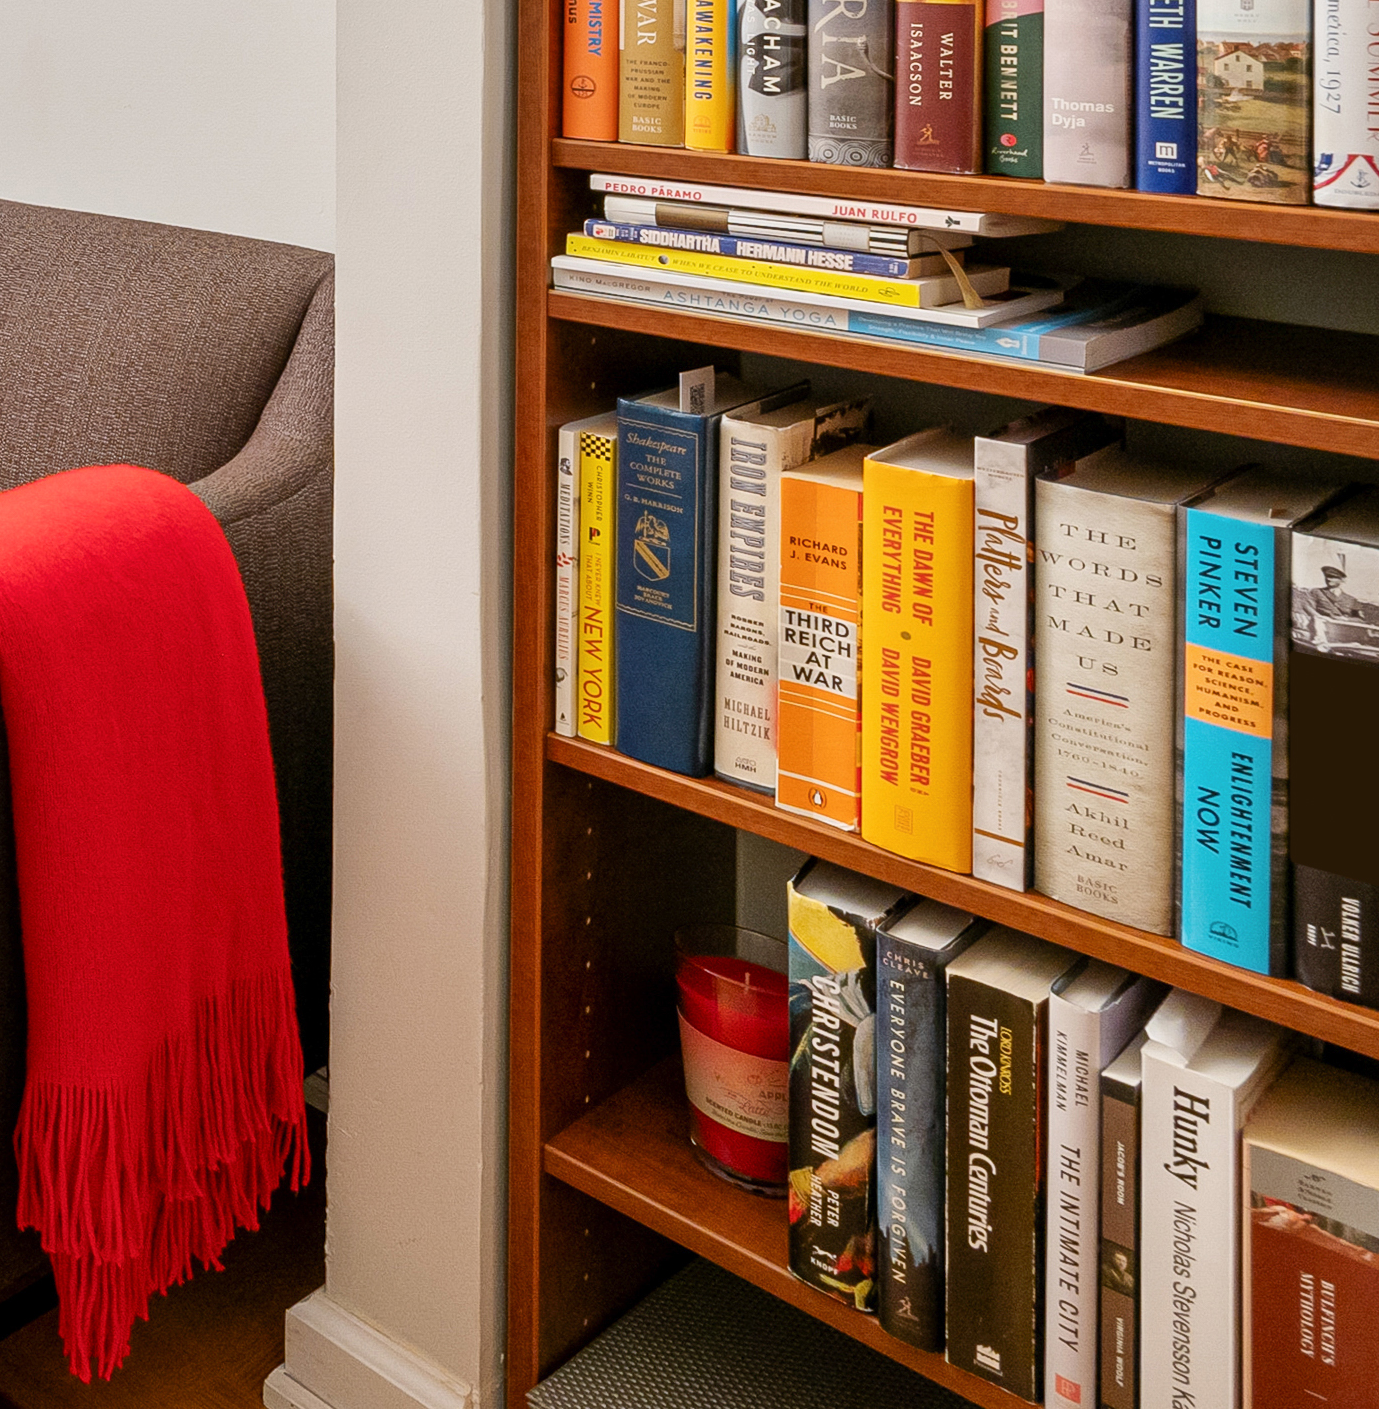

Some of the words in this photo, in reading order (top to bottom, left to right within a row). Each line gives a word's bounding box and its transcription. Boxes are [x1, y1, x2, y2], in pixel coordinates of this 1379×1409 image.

[694, 0, 714, 100] AWAKENING
[909, 23, 923, 107] ISAACSON
[939, 33, 954, 100] WALTER
[1150, 43, 1184, 120] WARREN
[1319, 70, 1341, 114] 1927
[1052, 97, 1114, 113] Thomas
[1052, 113, 1085, 128] Dyja
[605, 182, 646, 195] PEDRO
[651, 185, 702, 201] PÁRAMO
[832, 205, 866, 219] JUAN
[872, 207, 917, 224] RULFO
[640, 229, 720, 253] SIDDHARTHA
[736, 241, 805, 266] HERMANN
[807, 251, 853, 271] HESSE
[664, 291, 770, 316] ASHTANGA
[780, 306, 837, 327] YOGA
[626, 432, 687, 456] Shakespeare
[645, 454, 667, 466] THE
[630, 462, 682, 481] COMPLETE
[637, 474, 675, 489] WORKS
[730, 437, 767, 497] IRON
[913, 511, 934, 545] THE
[1060, 523, 1136, 550] THE
[729, 499, 765, 602] EMPIRES
[882, 505, 902, 613] EVERYTHING
[1038, 549, 1163, 588] WORDS
[913, 552, 934, 599] DAWN
[1198, 536, 1222, 629] PINKER
[1234, 542, 1258, 638] STEVEN
[913, 603, 934, 626] OF
[1049, 585, 1149, 618] THAT
[584, 605, 603, 662] NEW
[785, 610, 850, 638] THIRD
[785, 627, 851, 658] REICH
[1047, 615, 1151, 652] MADE
[792, 665, 843, 692] WAR
[805, 652, 832, 670] AT
[1077, 655, 1118, 677] US
[583, 669, 603, 729] YORK
[724, 697, 770, 721] MICHAEL
[724, 716, 770, 740] HILTZIK
[1196, 786, 1220, 854] NOW
[1230, 751, 1253, 909] ENLIGHTENMENT
[970, 1014, 998, 1055] The
[811, 975, 840, 1161] CHRISTENDOM
[1056, 1030, 1068, 1112] KIMMELMAN
[1075, 1049, 1089, 1108] MICHAEL
[969, 1056, 997, 1150] Ottoman
[1163, 1085, 1210, 1191] Hunky
[1060, 1143, 1081, 1187] THE
[810, 1174, 822, 1227] HEATHER
[827, 1189, 839, 1227] PETER
[968, 1152, 996, 1253] Centuries
[1059, 1190, 1081, 1294] INTIMATE
[1173, 1200, 1197, 1279] Nicholas
[1058, 1299, 1079, 1353] CITY
[1172, 1281, 1197, 1387] Stevensson
